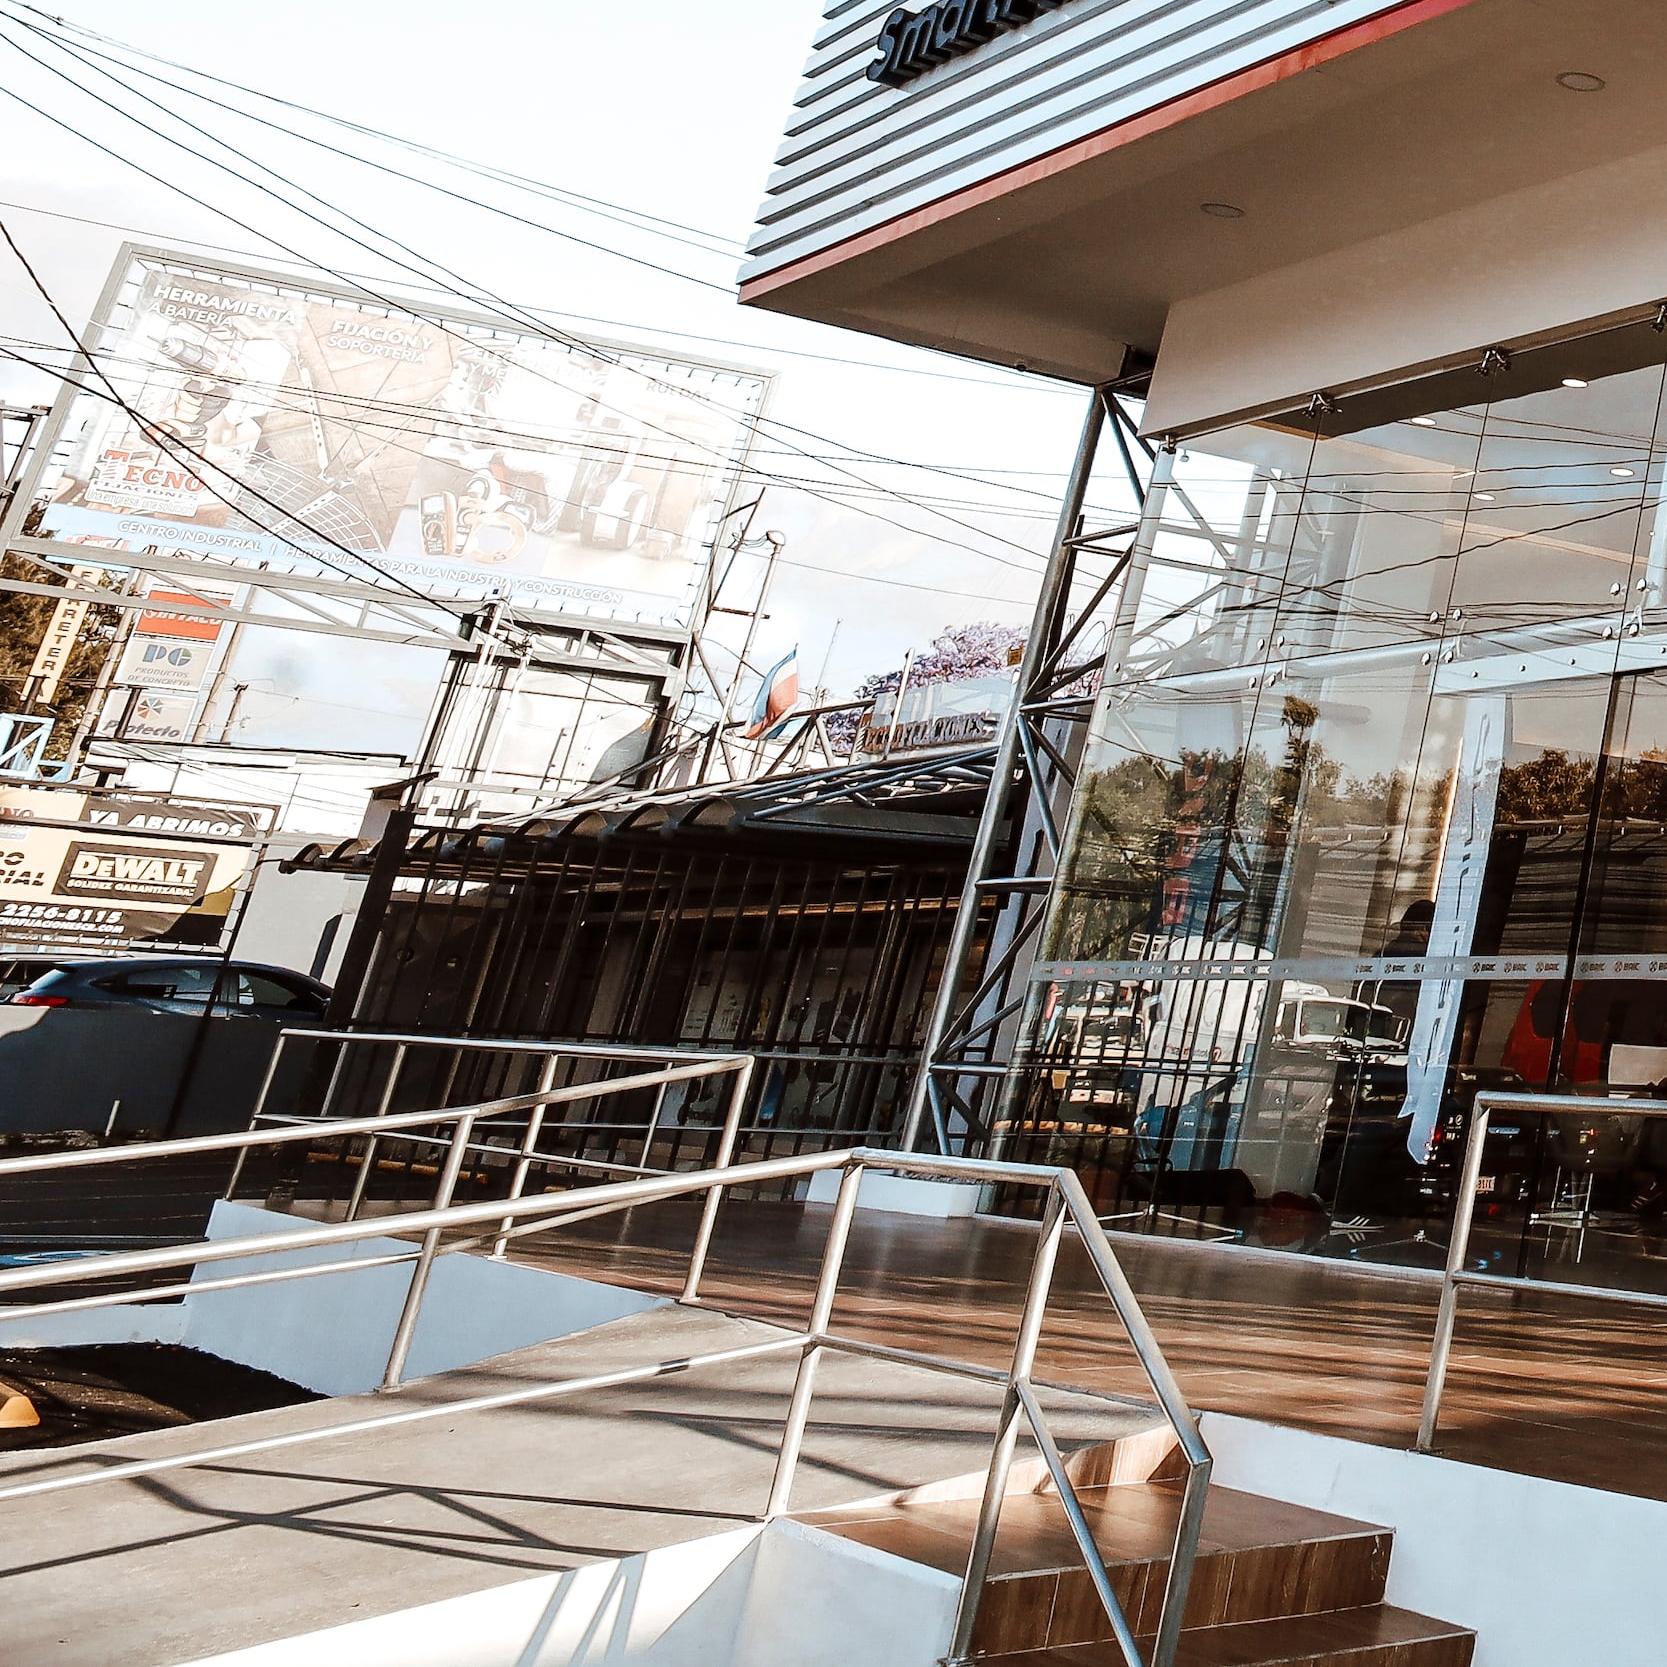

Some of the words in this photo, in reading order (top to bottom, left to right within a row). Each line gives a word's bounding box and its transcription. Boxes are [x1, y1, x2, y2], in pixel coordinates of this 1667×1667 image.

[148, 302, 162, 314] A
[165, 304, 234, 328] BATERÍA
[153, 286, 296, 325] HERRAMIENTA
[332, 319, 416, 347] FIJACIÓN
[421, 337, 434, 351] Y
[327, 335, 426, 364] SOPORTERÍA
[102, 449, 205, 492] TECNO
[118, 521, 177, 539] CENTRO
[178, 529, 262, 552] INDUSTRIAL
[283, 547, 389, 570] HERRAMIENTAS
[391, 561, 424, 576] PARA
[425, 565, 442, 578] LA
[443, 569, 513, 588] INDUSTRIA
[515, 579, 524, 592] Y
[524, 581, 623, 604] CONSTRUCCIÓN
[135, 667, 188, 679] PRODUCTOS
[103, 719, 181, 738] Potecto
[90, 809, 120, 826] YA
[127, 814, 245, 837] ABRIMOS
[67, 879, 113, 891] SOLIDEZ
[1, 903, 123, 924] 2256-8115
